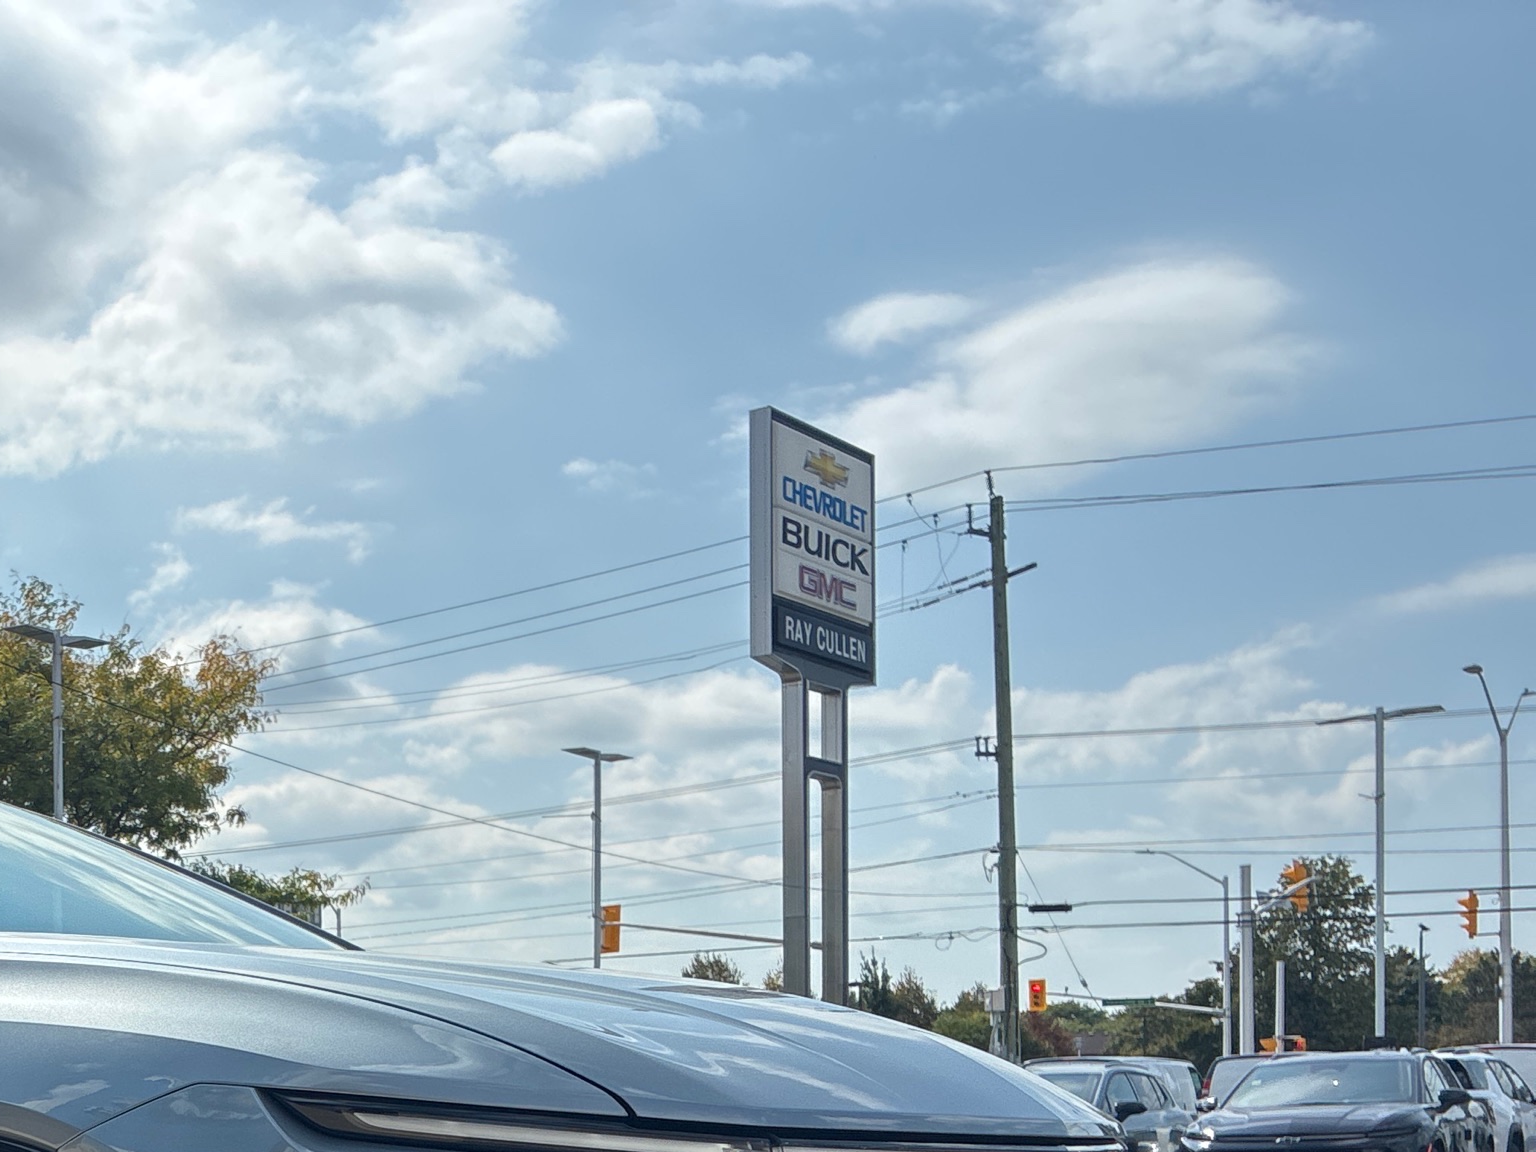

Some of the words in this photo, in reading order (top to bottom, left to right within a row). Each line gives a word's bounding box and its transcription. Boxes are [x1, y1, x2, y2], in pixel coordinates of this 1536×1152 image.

[782, 476, 867, 533] CHEVROLET
[782, 516, 869, 576] BUICK
[798, 561, 857, 611] GMC
[785, 615, 813, 646] RAY
[816, 624, 867, 665] CULLEN
